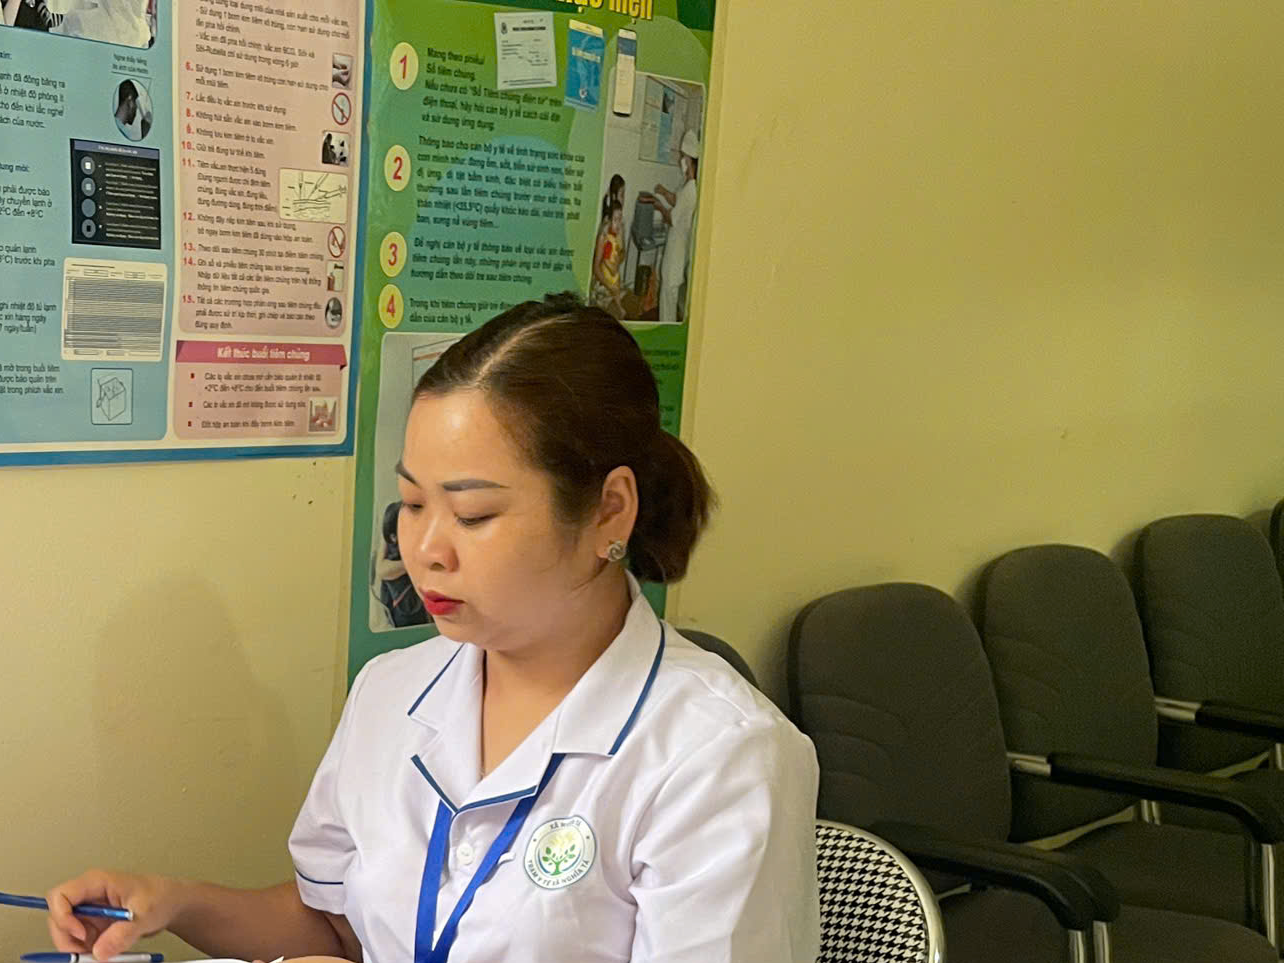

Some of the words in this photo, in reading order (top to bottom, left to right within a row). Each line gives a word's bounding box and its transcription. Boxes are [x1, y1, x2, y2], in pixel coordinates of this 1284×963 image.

[400, 54, 407, 80] 1
[392, 155, 403, 181] 2
[387, 242, 398, 267] 3
[386, 293, 396, 319] 4
